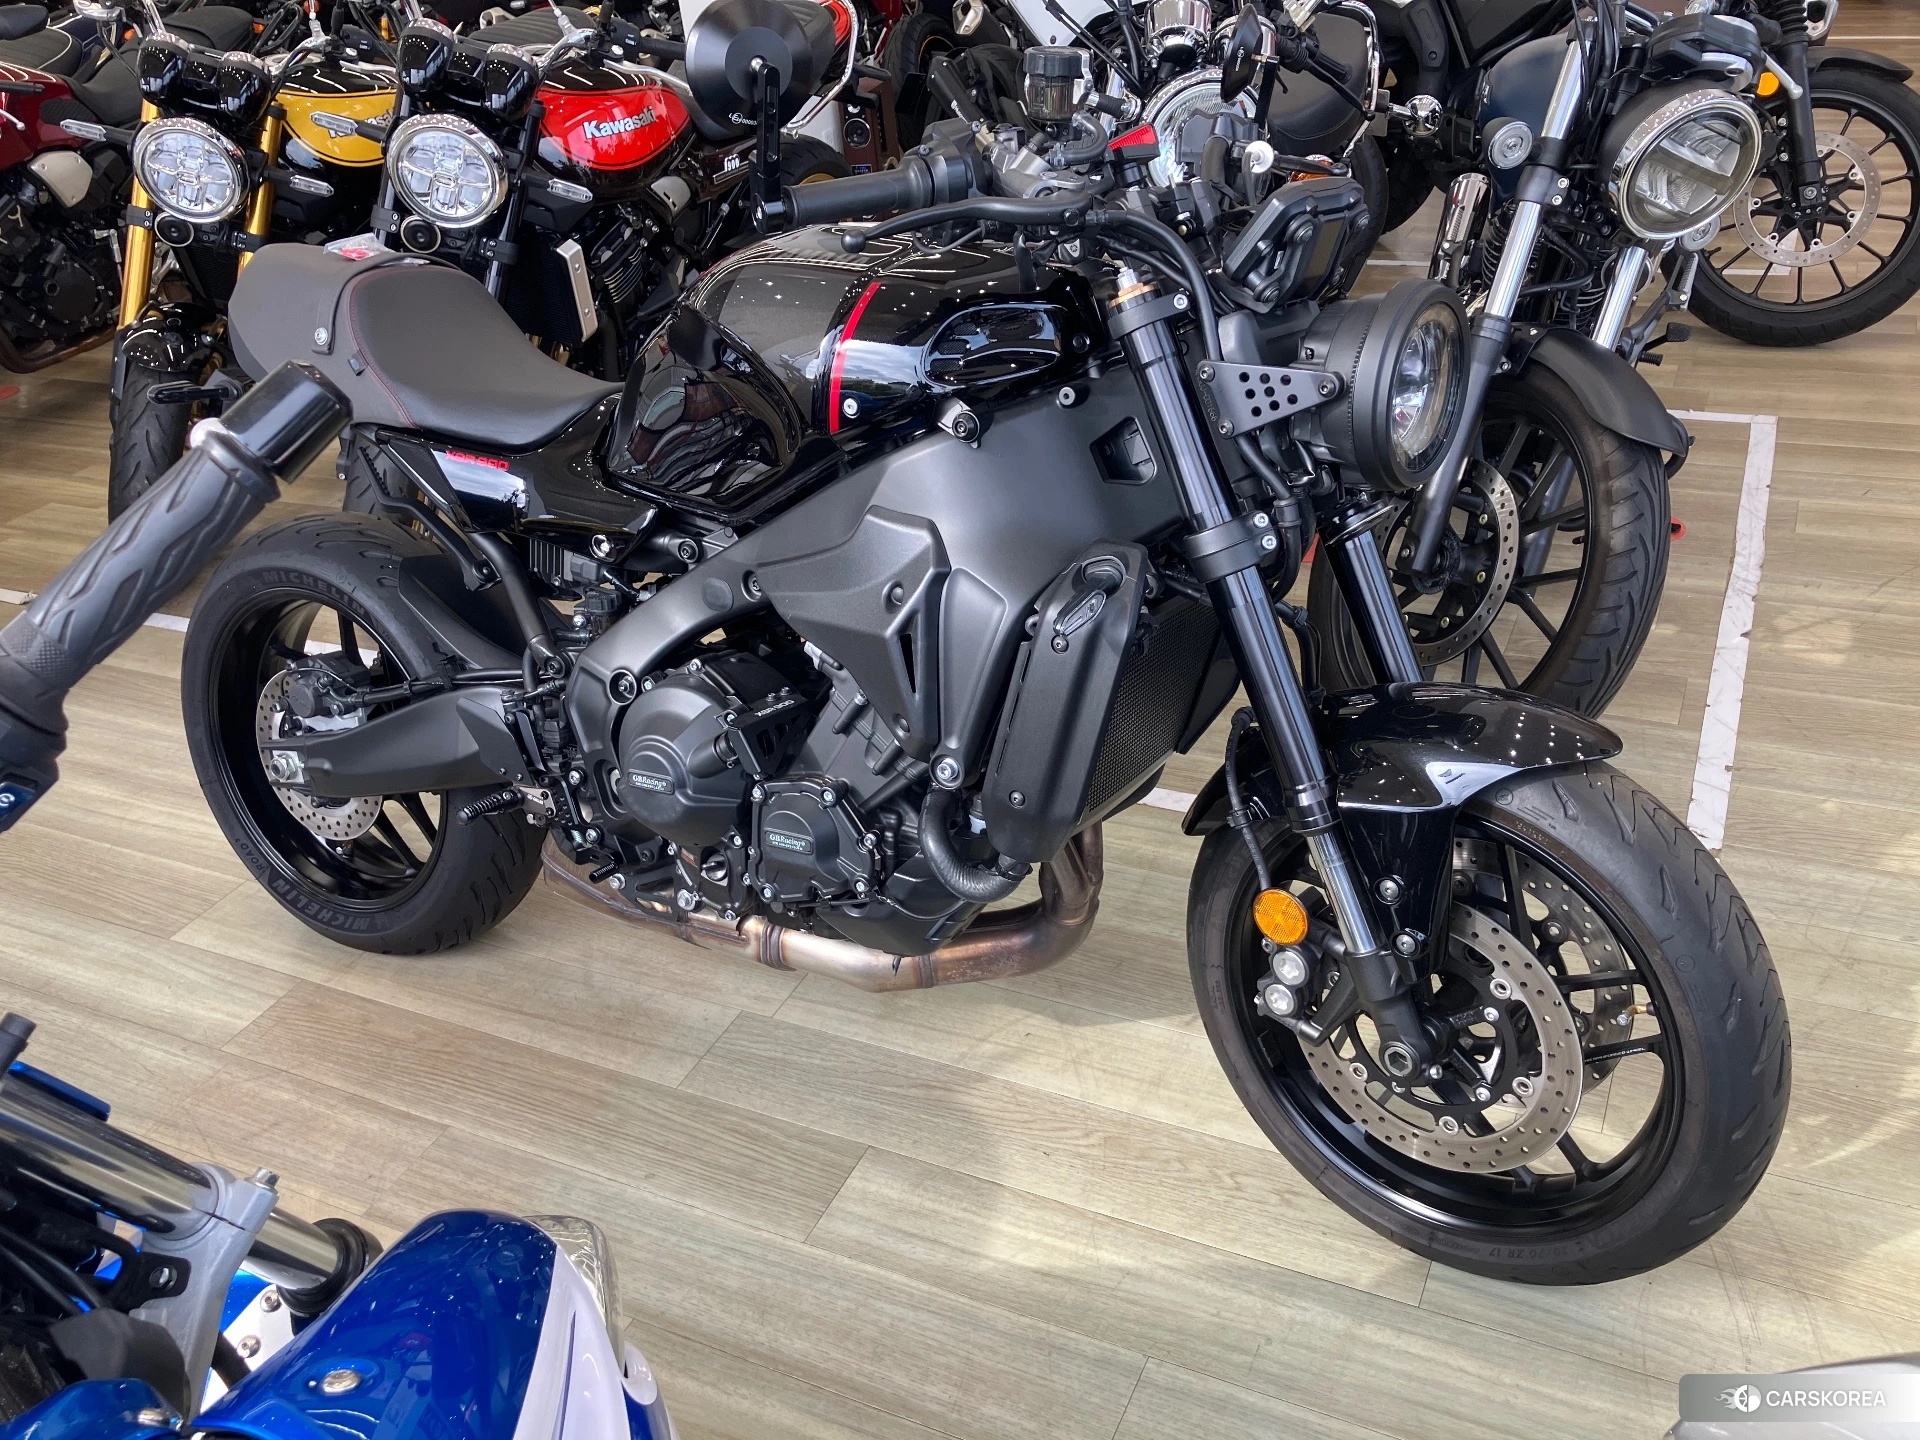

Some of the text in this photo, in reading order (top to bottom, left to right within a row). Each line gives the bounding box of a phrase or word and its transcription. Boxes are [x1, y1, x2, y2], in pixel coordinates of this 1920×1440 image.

[582, 105, 657, 139] Kawasaki
[261, 570, 366, 616] MICHELIN
[240, 843, 265, 871] ROAD
[271, 878, 371, 931] MICHELIN
[1489, 1247, 1502, 1257] 17
[1508, 1248, 1525, 1259] ZR
